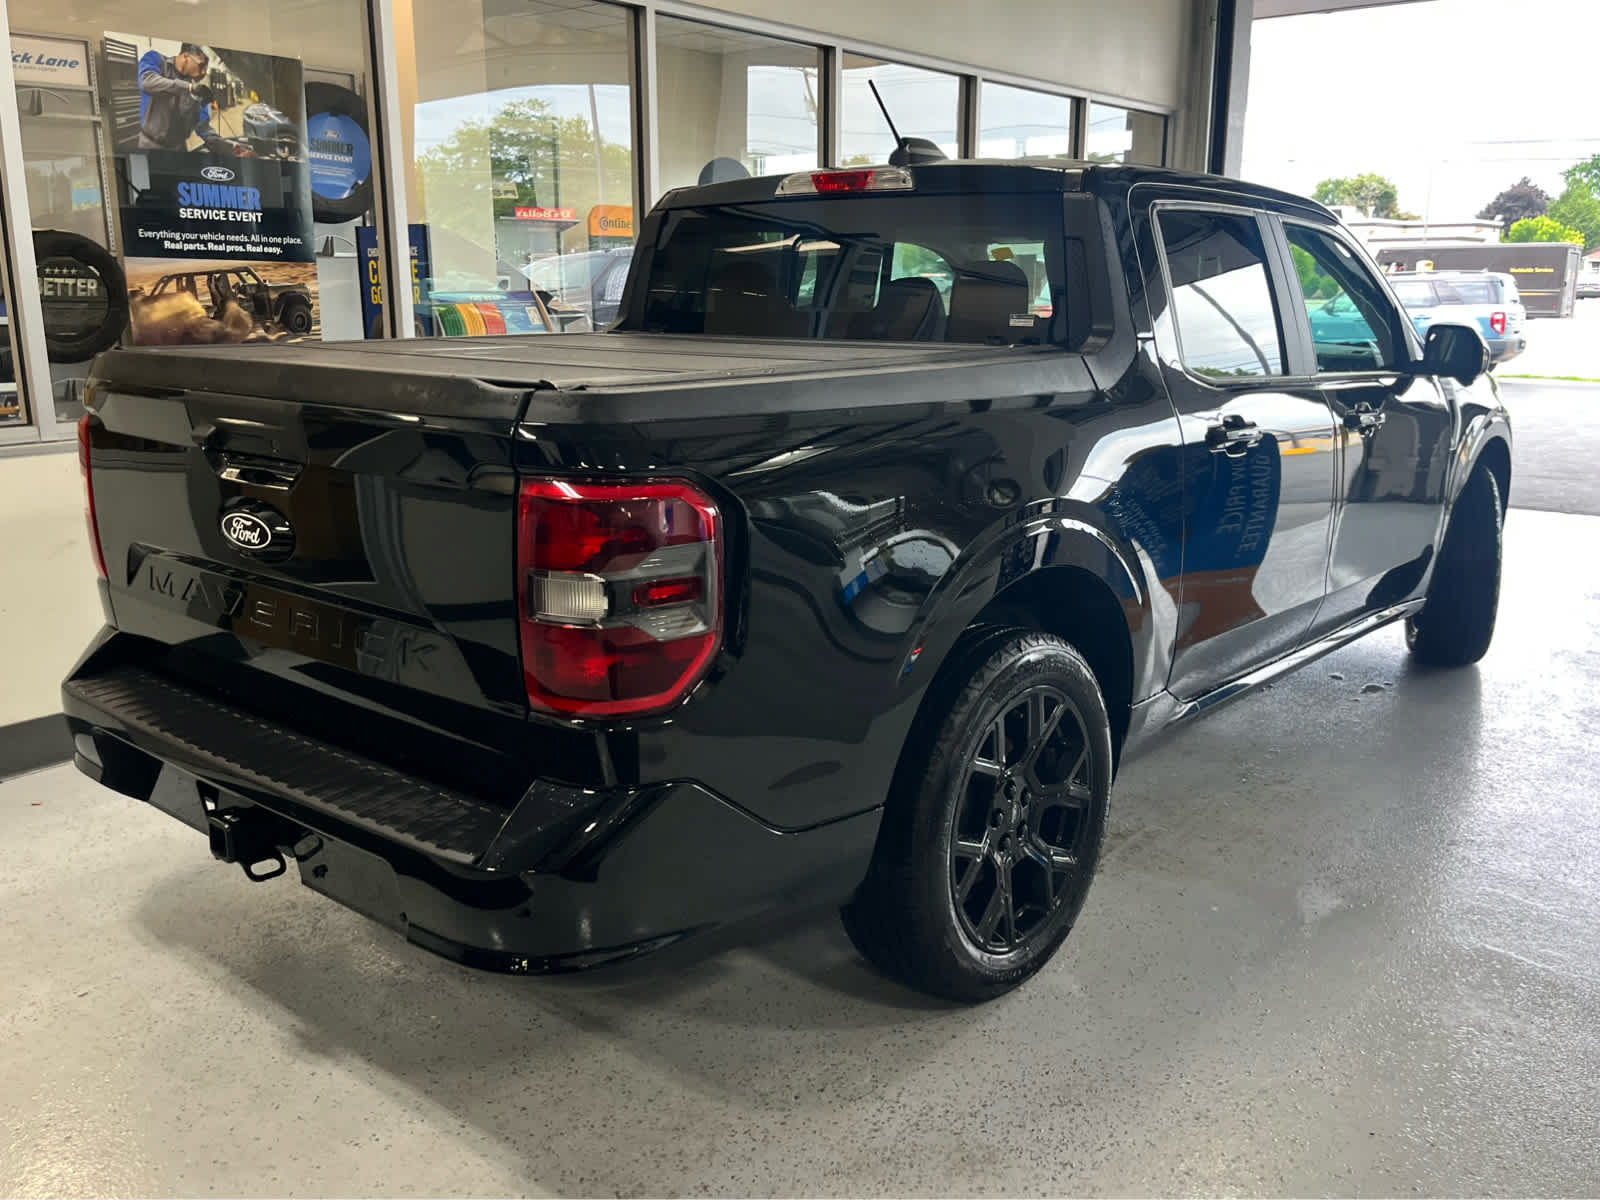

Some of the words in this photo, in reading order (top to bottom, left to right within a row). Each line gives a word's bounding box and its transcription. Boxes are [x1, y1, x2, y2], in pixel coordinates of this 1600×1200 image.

[35, 53, 79, 69] Lane
[177, 182, 262, 211] SUMMER
[179, 208, 226, 221] SERVICE
[228, 210, 263, 223] EVENT
[138, 228, 181, 241] Everything
[181, 232, 198, 241] your
[199, 231, 225, 242] vehicle
[226, 233, 250, 243] needs.
[250, 234, 260, 243] All
[261, 235, 268, 243] in
[268, 236, 282, 244] one
[282, 236, 303, 246] place.
[164, 240, 183, 250] Real
[183, 242, 207, 252] parts.
[208, 242, 225, 251] Real
[226, 244, 246, 253] pros.
[246, 243, 263, 253] Real
[263, 246, 283, 255] easy.
[229, 515, 262, 545] Ford
[148, 565, 434, 671] MAVERICK
